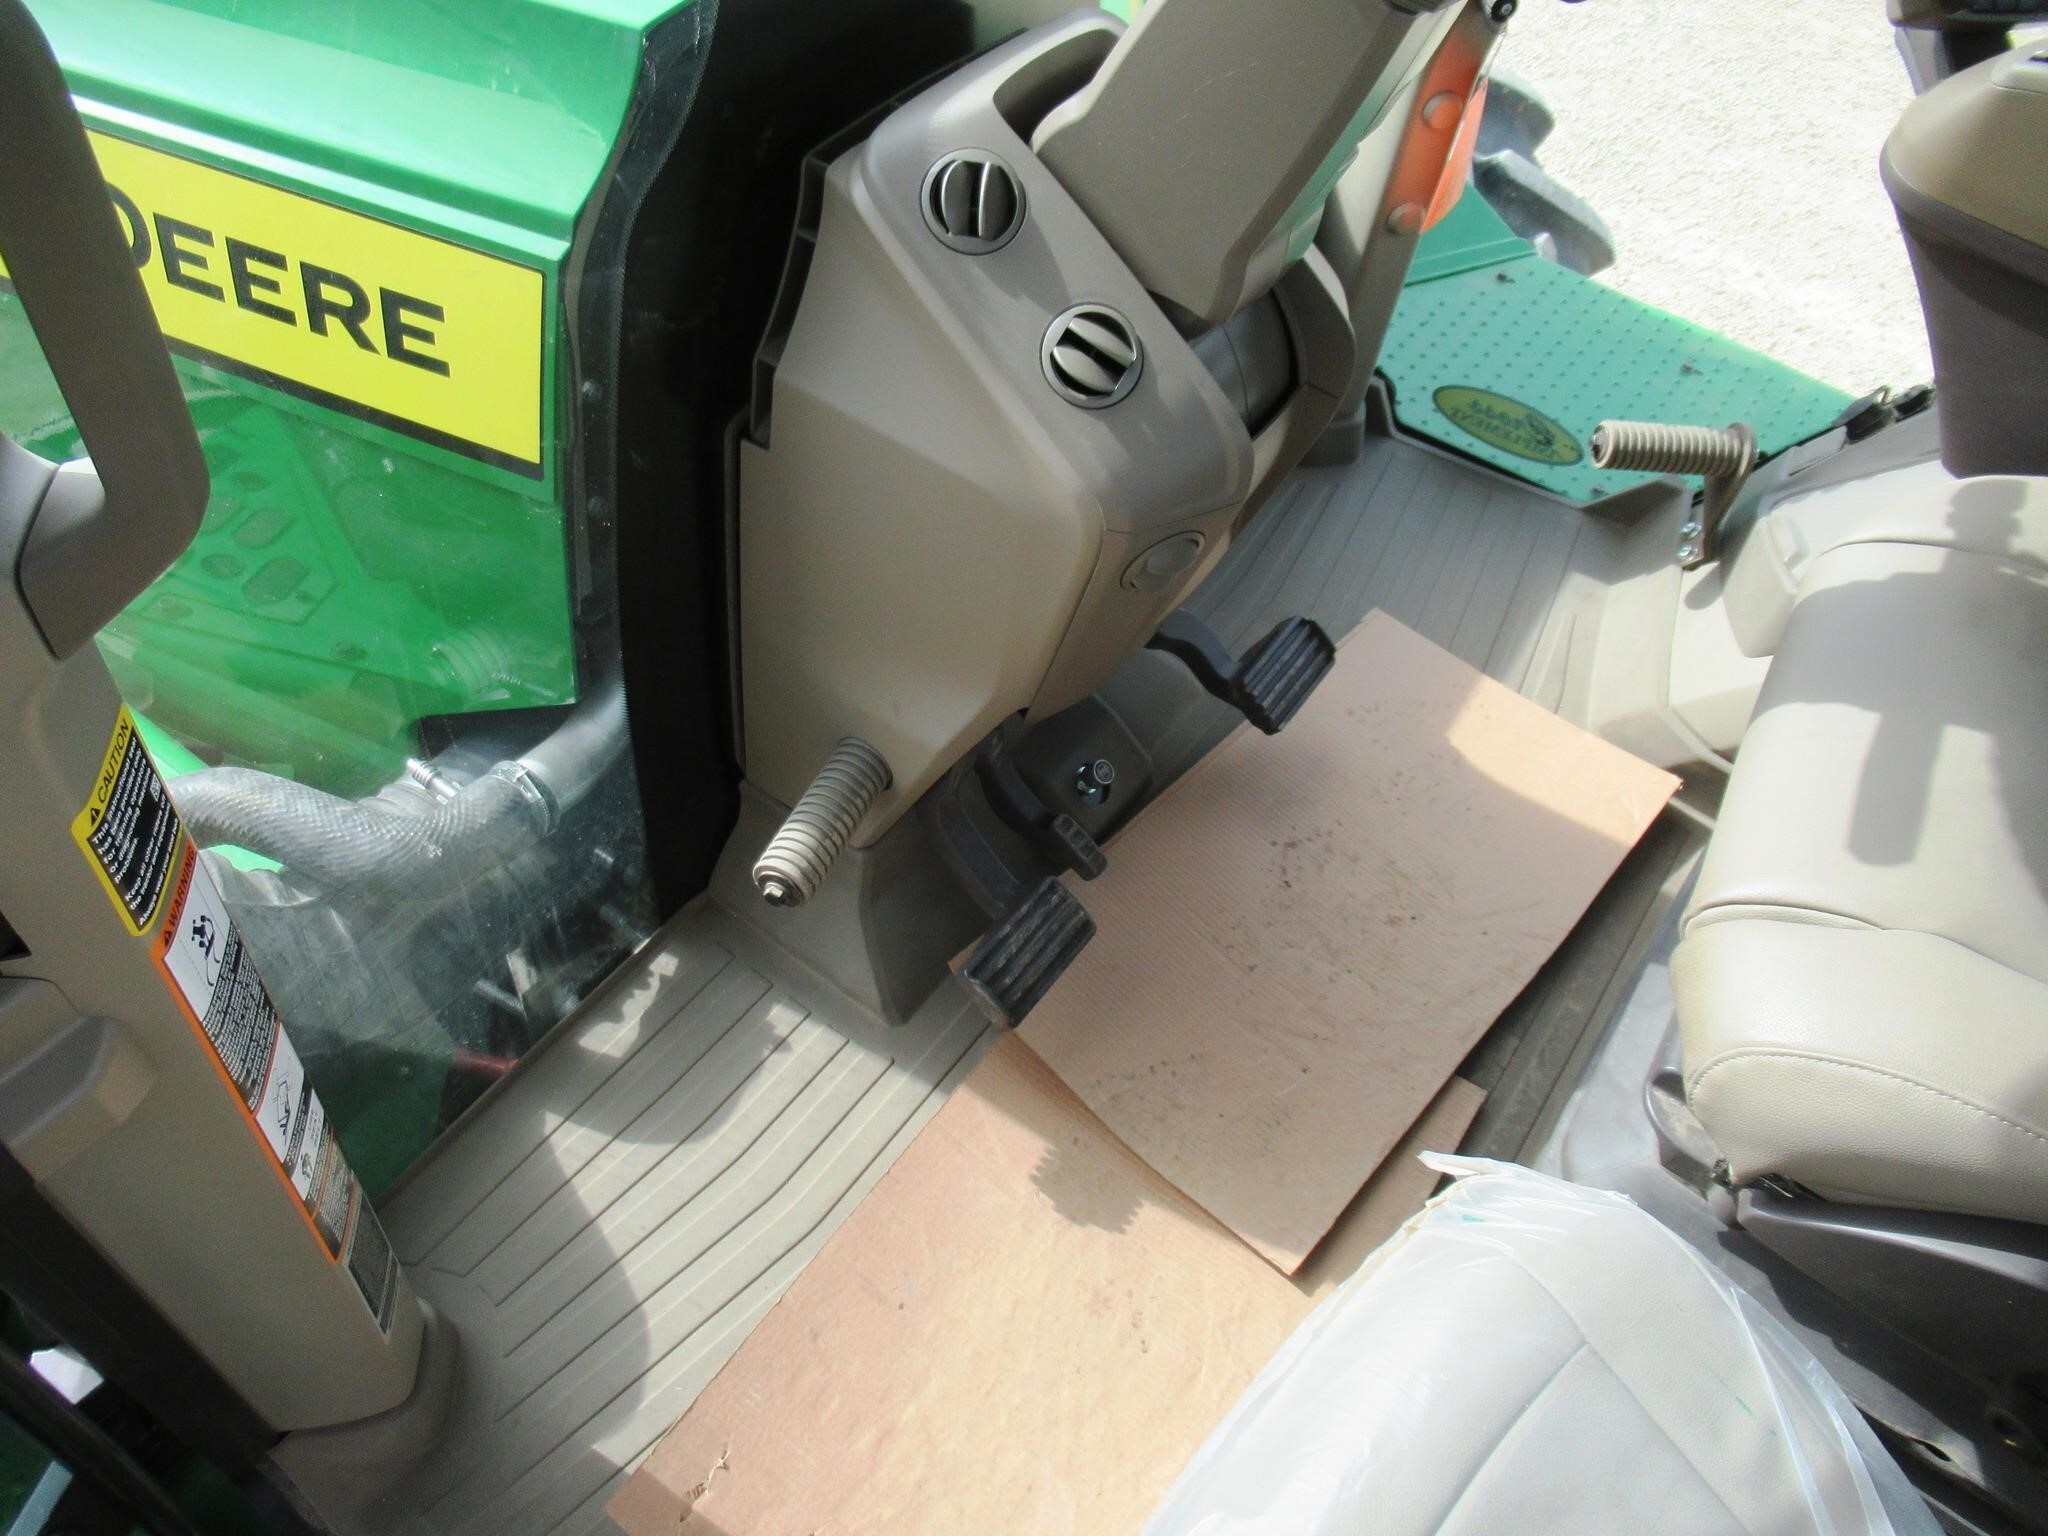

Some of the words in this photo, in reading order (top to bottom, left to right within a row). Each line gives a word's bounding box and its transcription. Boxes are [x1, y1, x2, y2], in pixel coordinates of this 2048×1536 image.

[97, 719, 129, 803] CAUTION
[91, 821, 109, 845] This
[115, 805, 133, 846] training
[98, 834, 112, 855] has
[125, 875, 142, 900] Keep
[169, 846, 196, 927] WARNING
